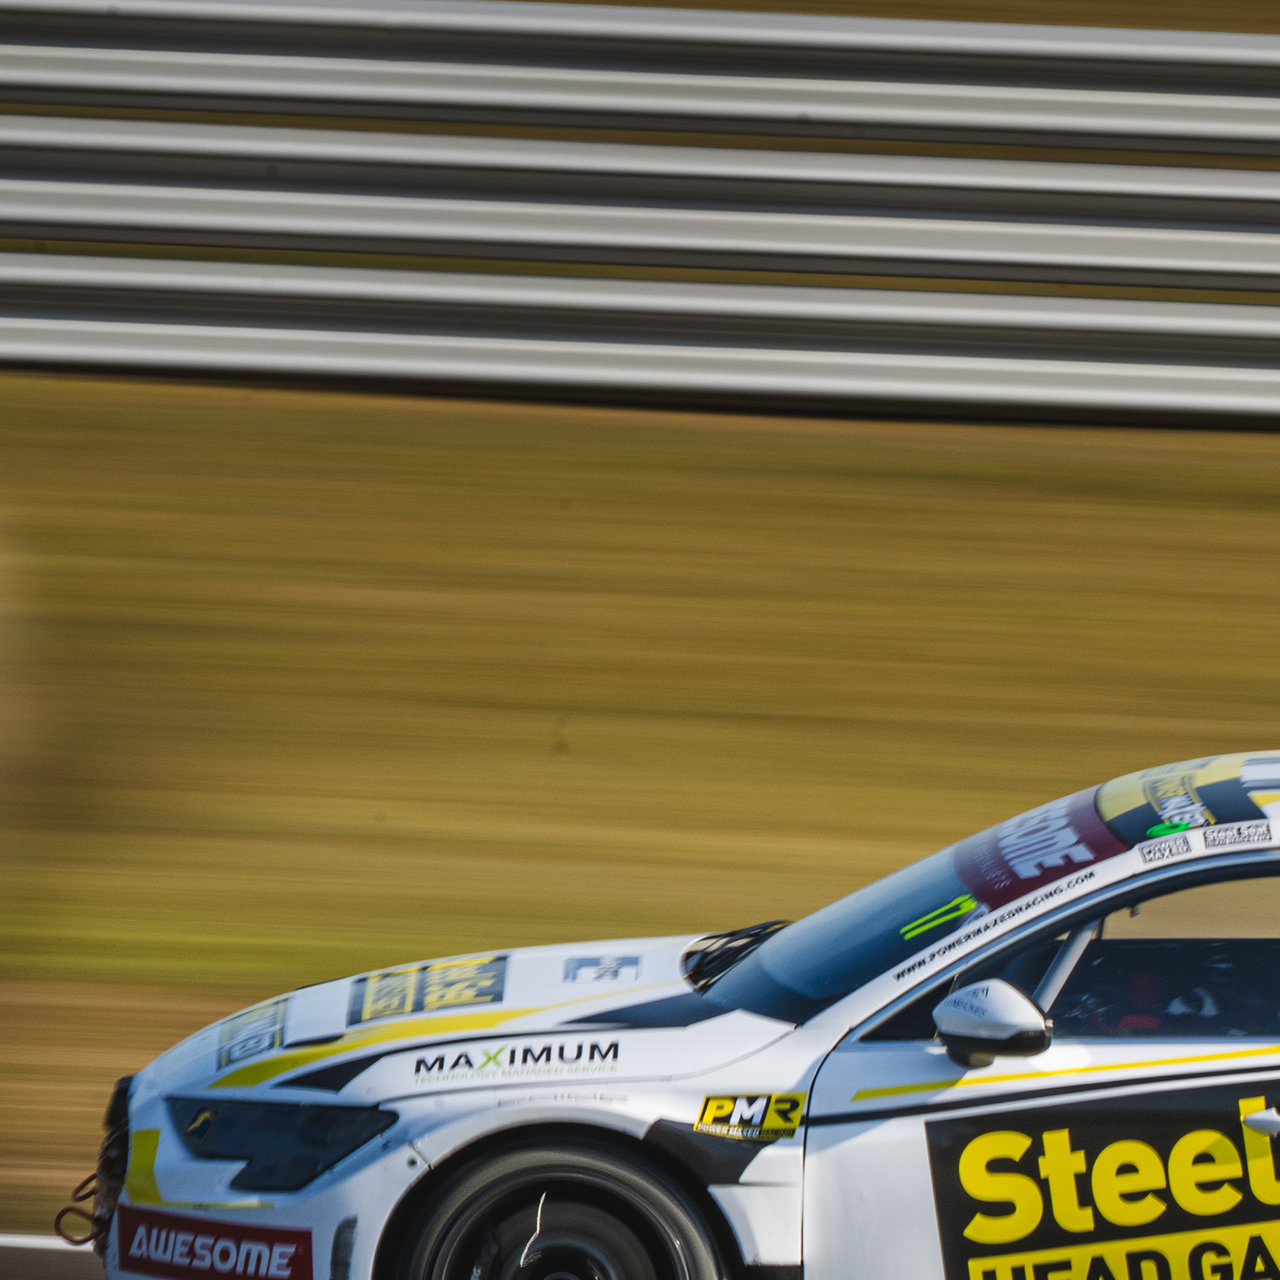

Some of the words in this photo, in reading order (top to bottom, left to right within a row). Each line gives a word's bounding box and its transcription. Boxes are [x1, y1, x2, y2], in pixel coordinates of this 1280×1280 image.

[414, 1040, 620, 1074] MAXIMUM
[702, 1096, 800, 1126] PMR
[128, 1223, 298, 1280] AWESOME
